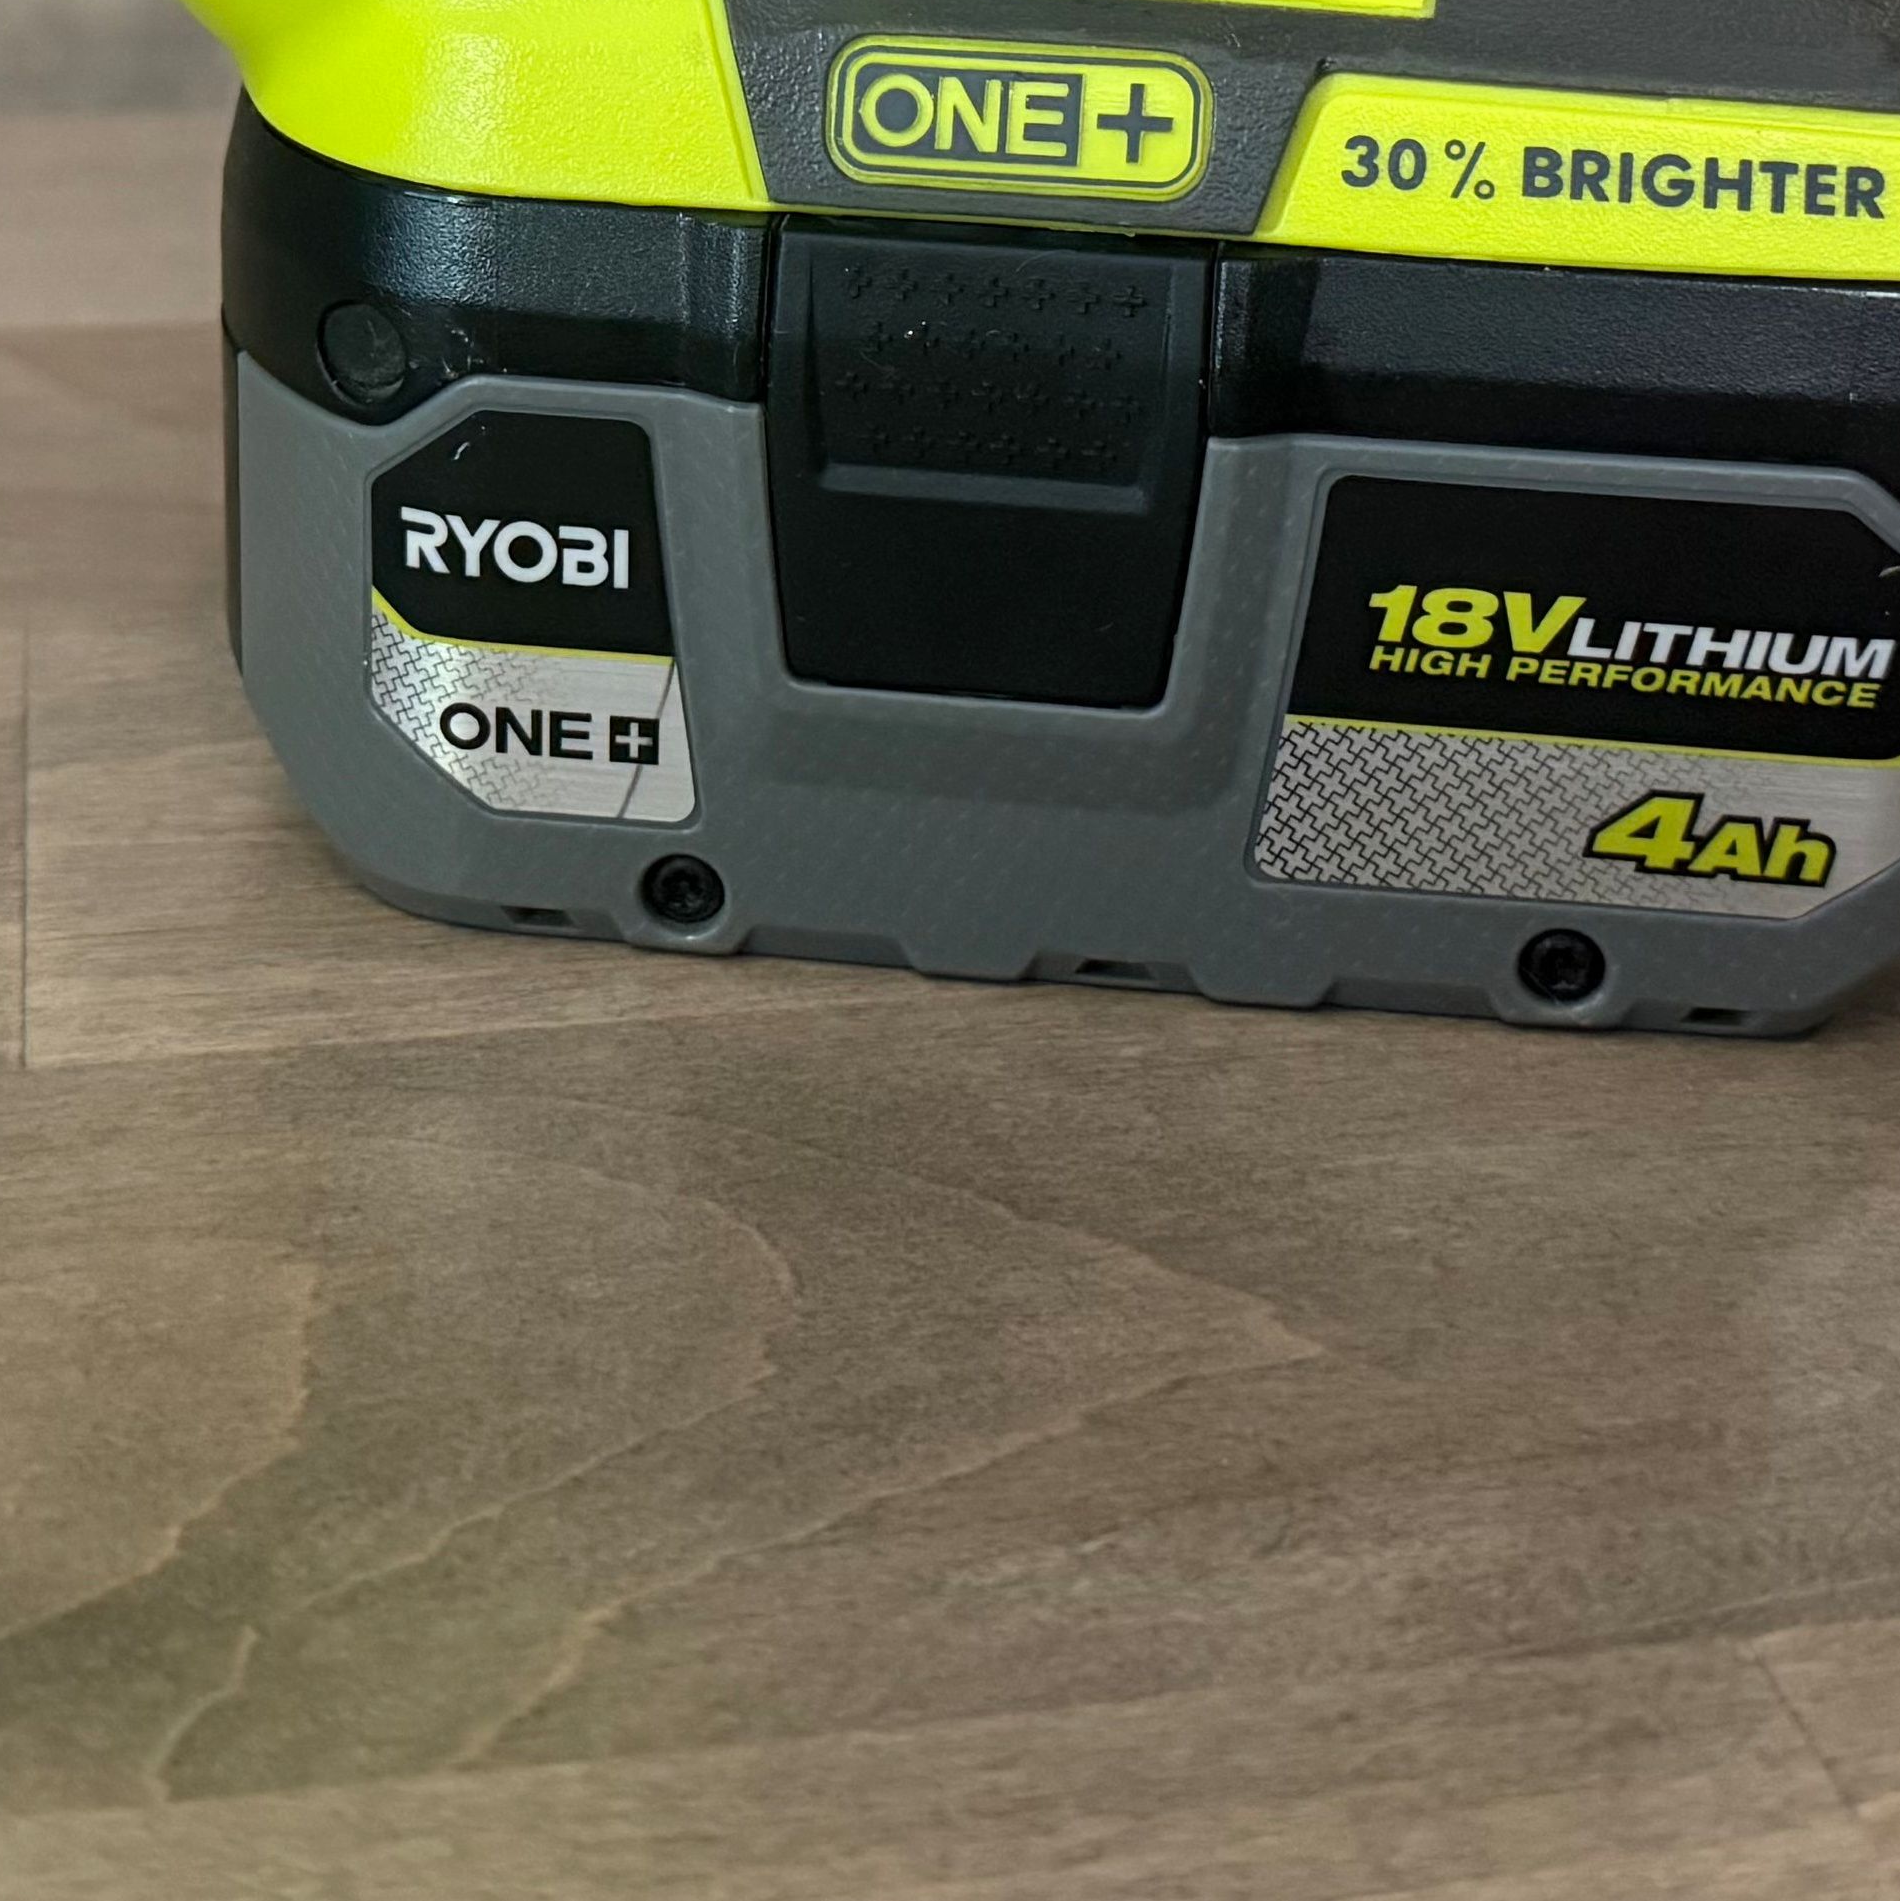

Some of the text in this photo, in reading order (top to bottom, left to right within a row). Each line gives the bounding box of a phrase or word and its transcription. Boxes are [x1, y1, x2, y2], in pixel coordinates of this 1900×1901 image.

[860, 73, 1173, 164] ONE+
[1522, 145, 1887, 220] BRIGHTER
[401, 506, 629, 589] RYOBI
[1369, 646, 1882, 709] HIGH PERFORMANCE
[1567, 620, 1897, 680] LITHIUM
[1588, 793, 1836, 885] 4Ah
